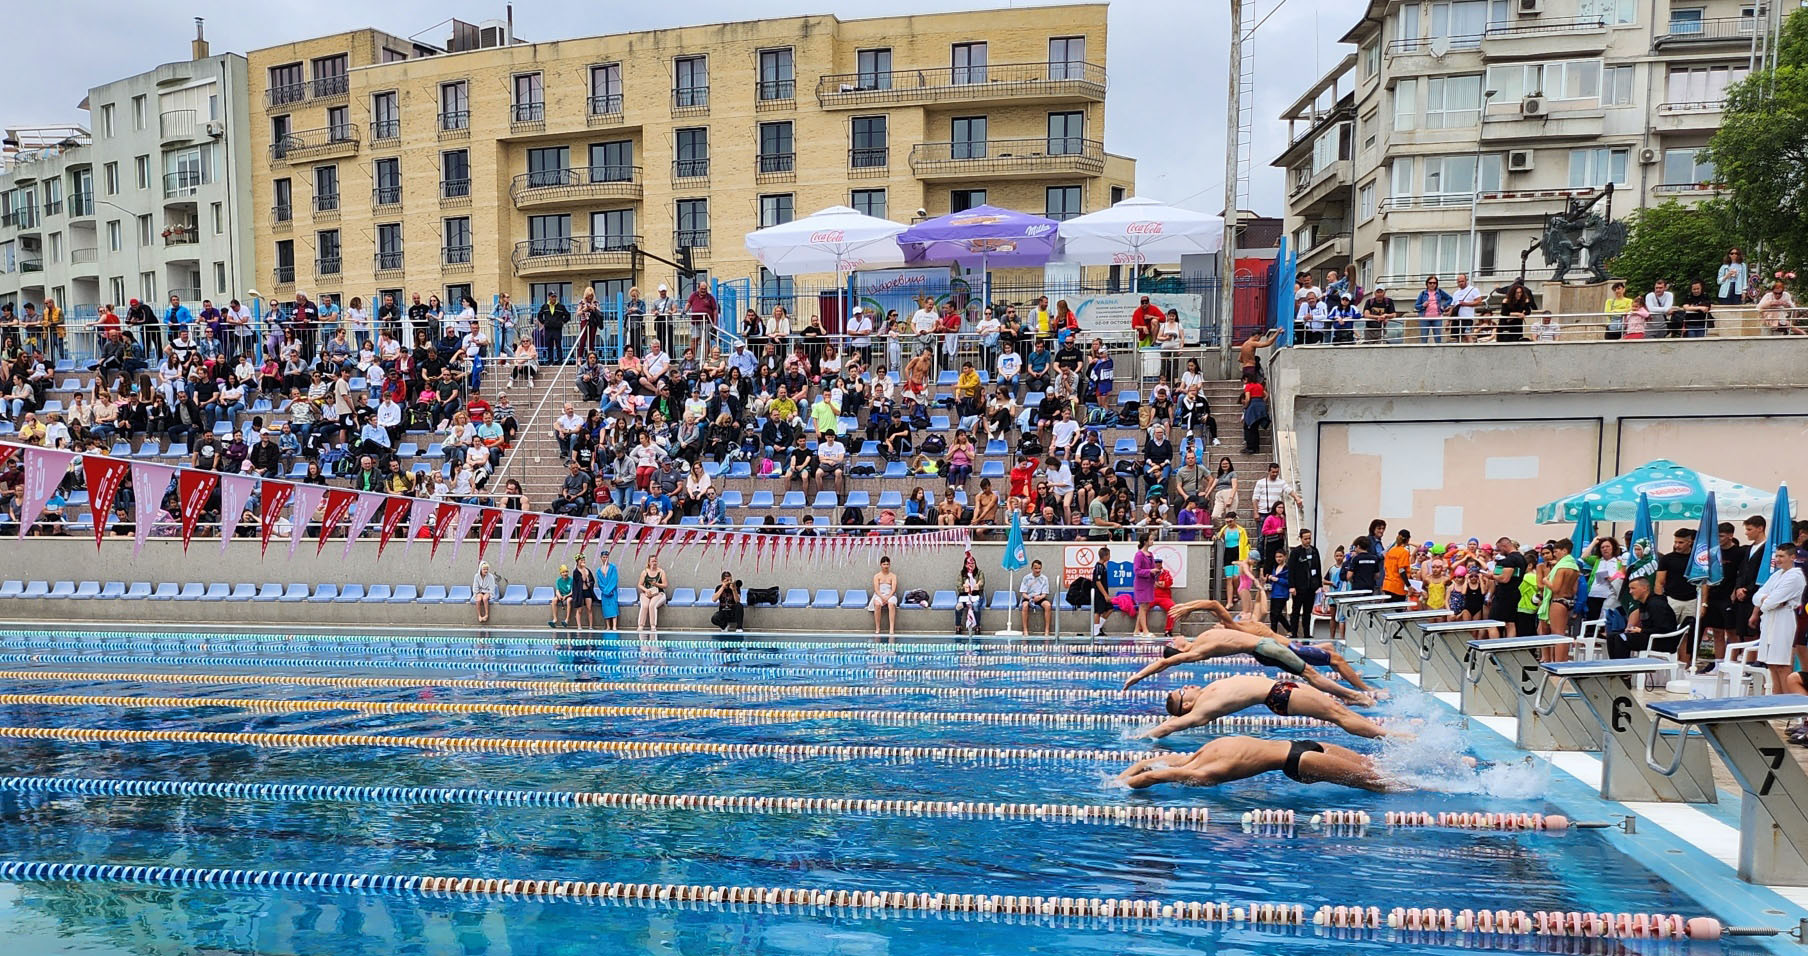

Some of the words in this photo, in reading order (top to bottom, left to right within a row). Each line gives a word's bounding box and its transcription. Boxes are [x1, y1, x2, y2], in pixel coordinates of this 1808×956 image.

[1025, 224, 1050, 236] Milka
[866, 274, 925, 296] Царевица
[1113, 570, 1126, 578] 2.70
[1392, 620, 1404, 640] 2
[1521, 665, 1538, 695] 5
[1611, 696, 1632, 733] 6
[1758, 747, 1785, 796] 7
